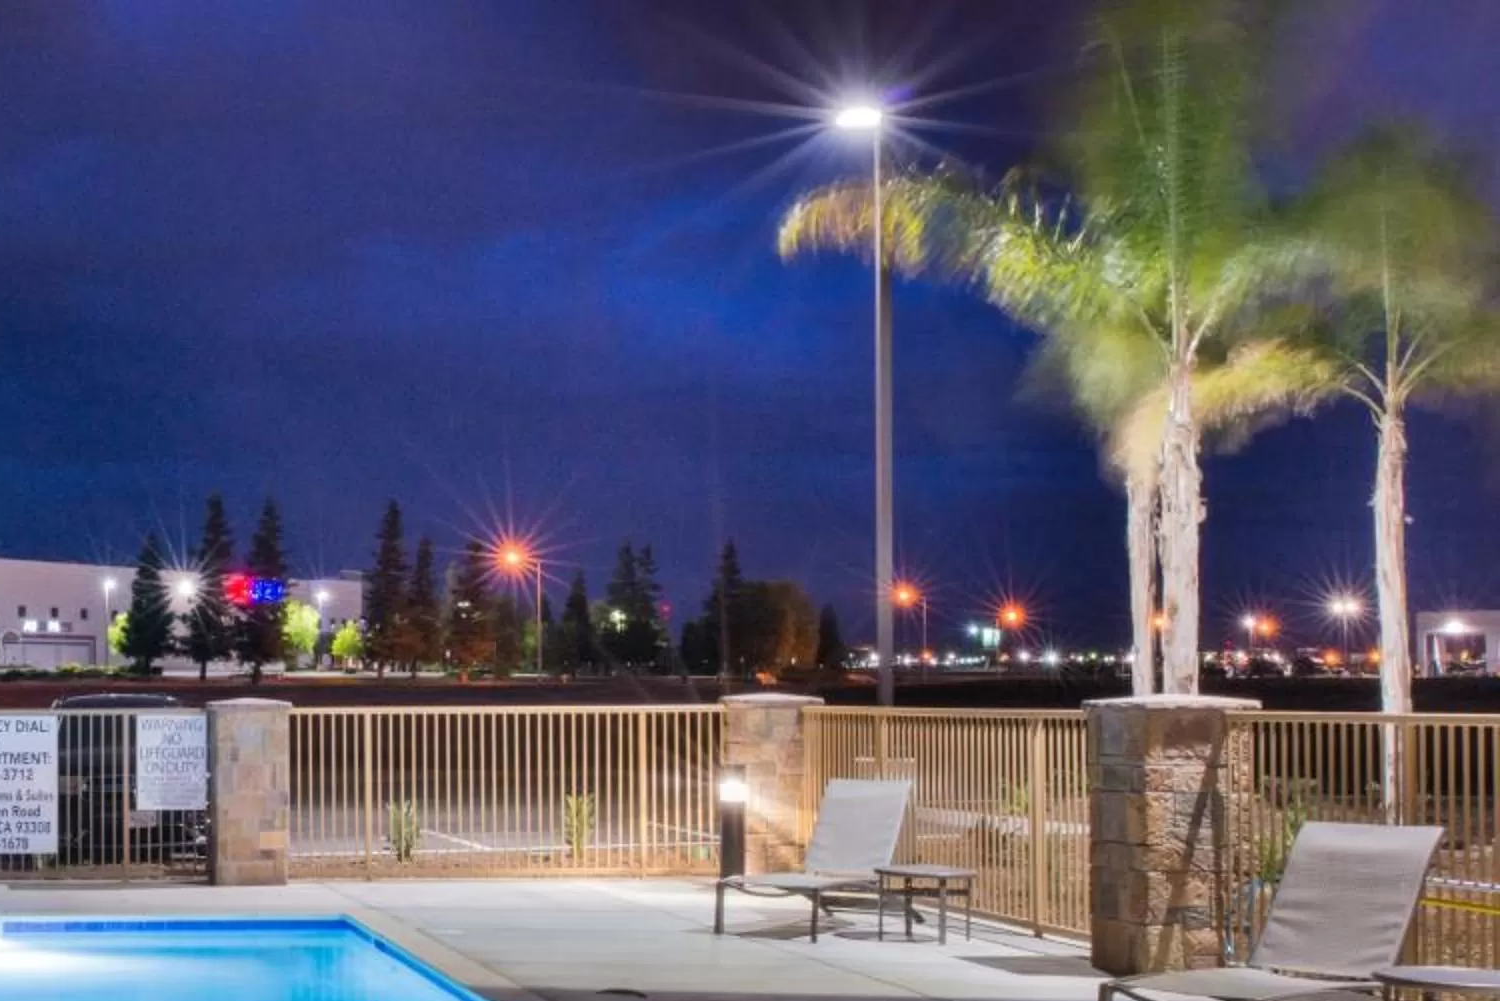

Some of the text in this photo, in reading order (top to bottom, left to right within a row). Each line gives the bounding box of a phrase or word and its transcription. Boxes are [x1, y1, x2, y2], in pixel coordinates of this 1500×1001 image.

[15, 719, 50, 733] DIAL:
[140, 746, 205, 760] LIFEGUARD
[15, 788, 24, 801] &
[26, 788, 53, 801] Suites
[11, 804, 41, 817] Road
